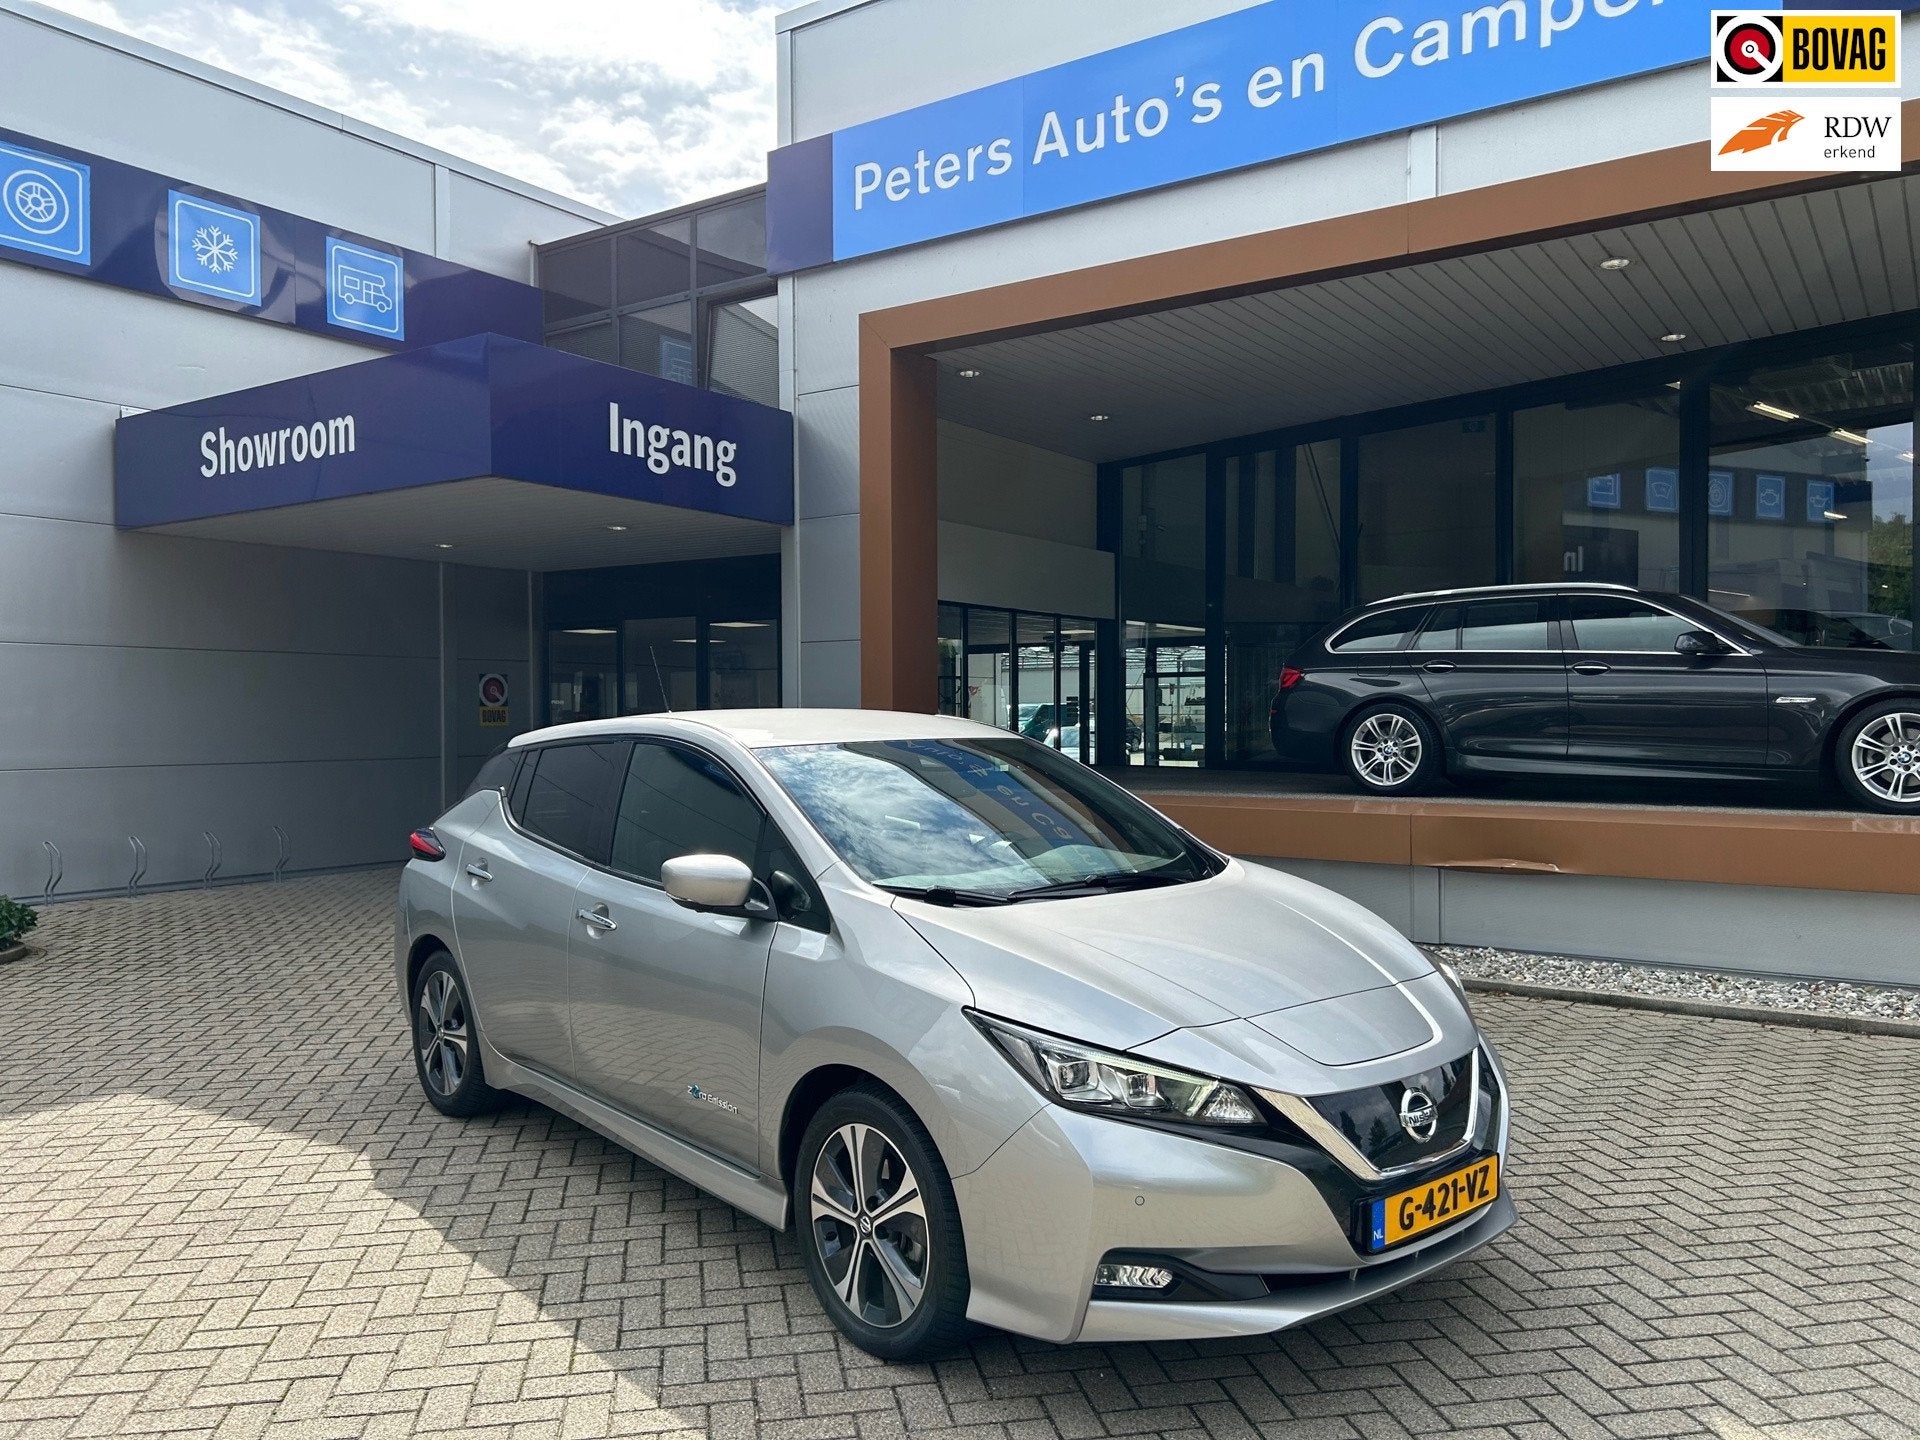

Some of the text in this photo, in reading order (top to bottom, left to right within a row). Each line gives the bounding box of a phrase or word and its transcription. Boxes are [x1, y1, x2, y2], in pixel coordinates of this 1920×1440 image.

[854, 137, 1013, 210] Peters
[1031, 76, 1223, 165] Auto's
[1247, 51, 1325, 108] en
[200, 414, 355, 478] Showroom
[608, 402, 737, 487] Ingang
[1399, 1164, 1490, 1231] G-421-VZ
[1373, 1228, 1384, 1241] NL
